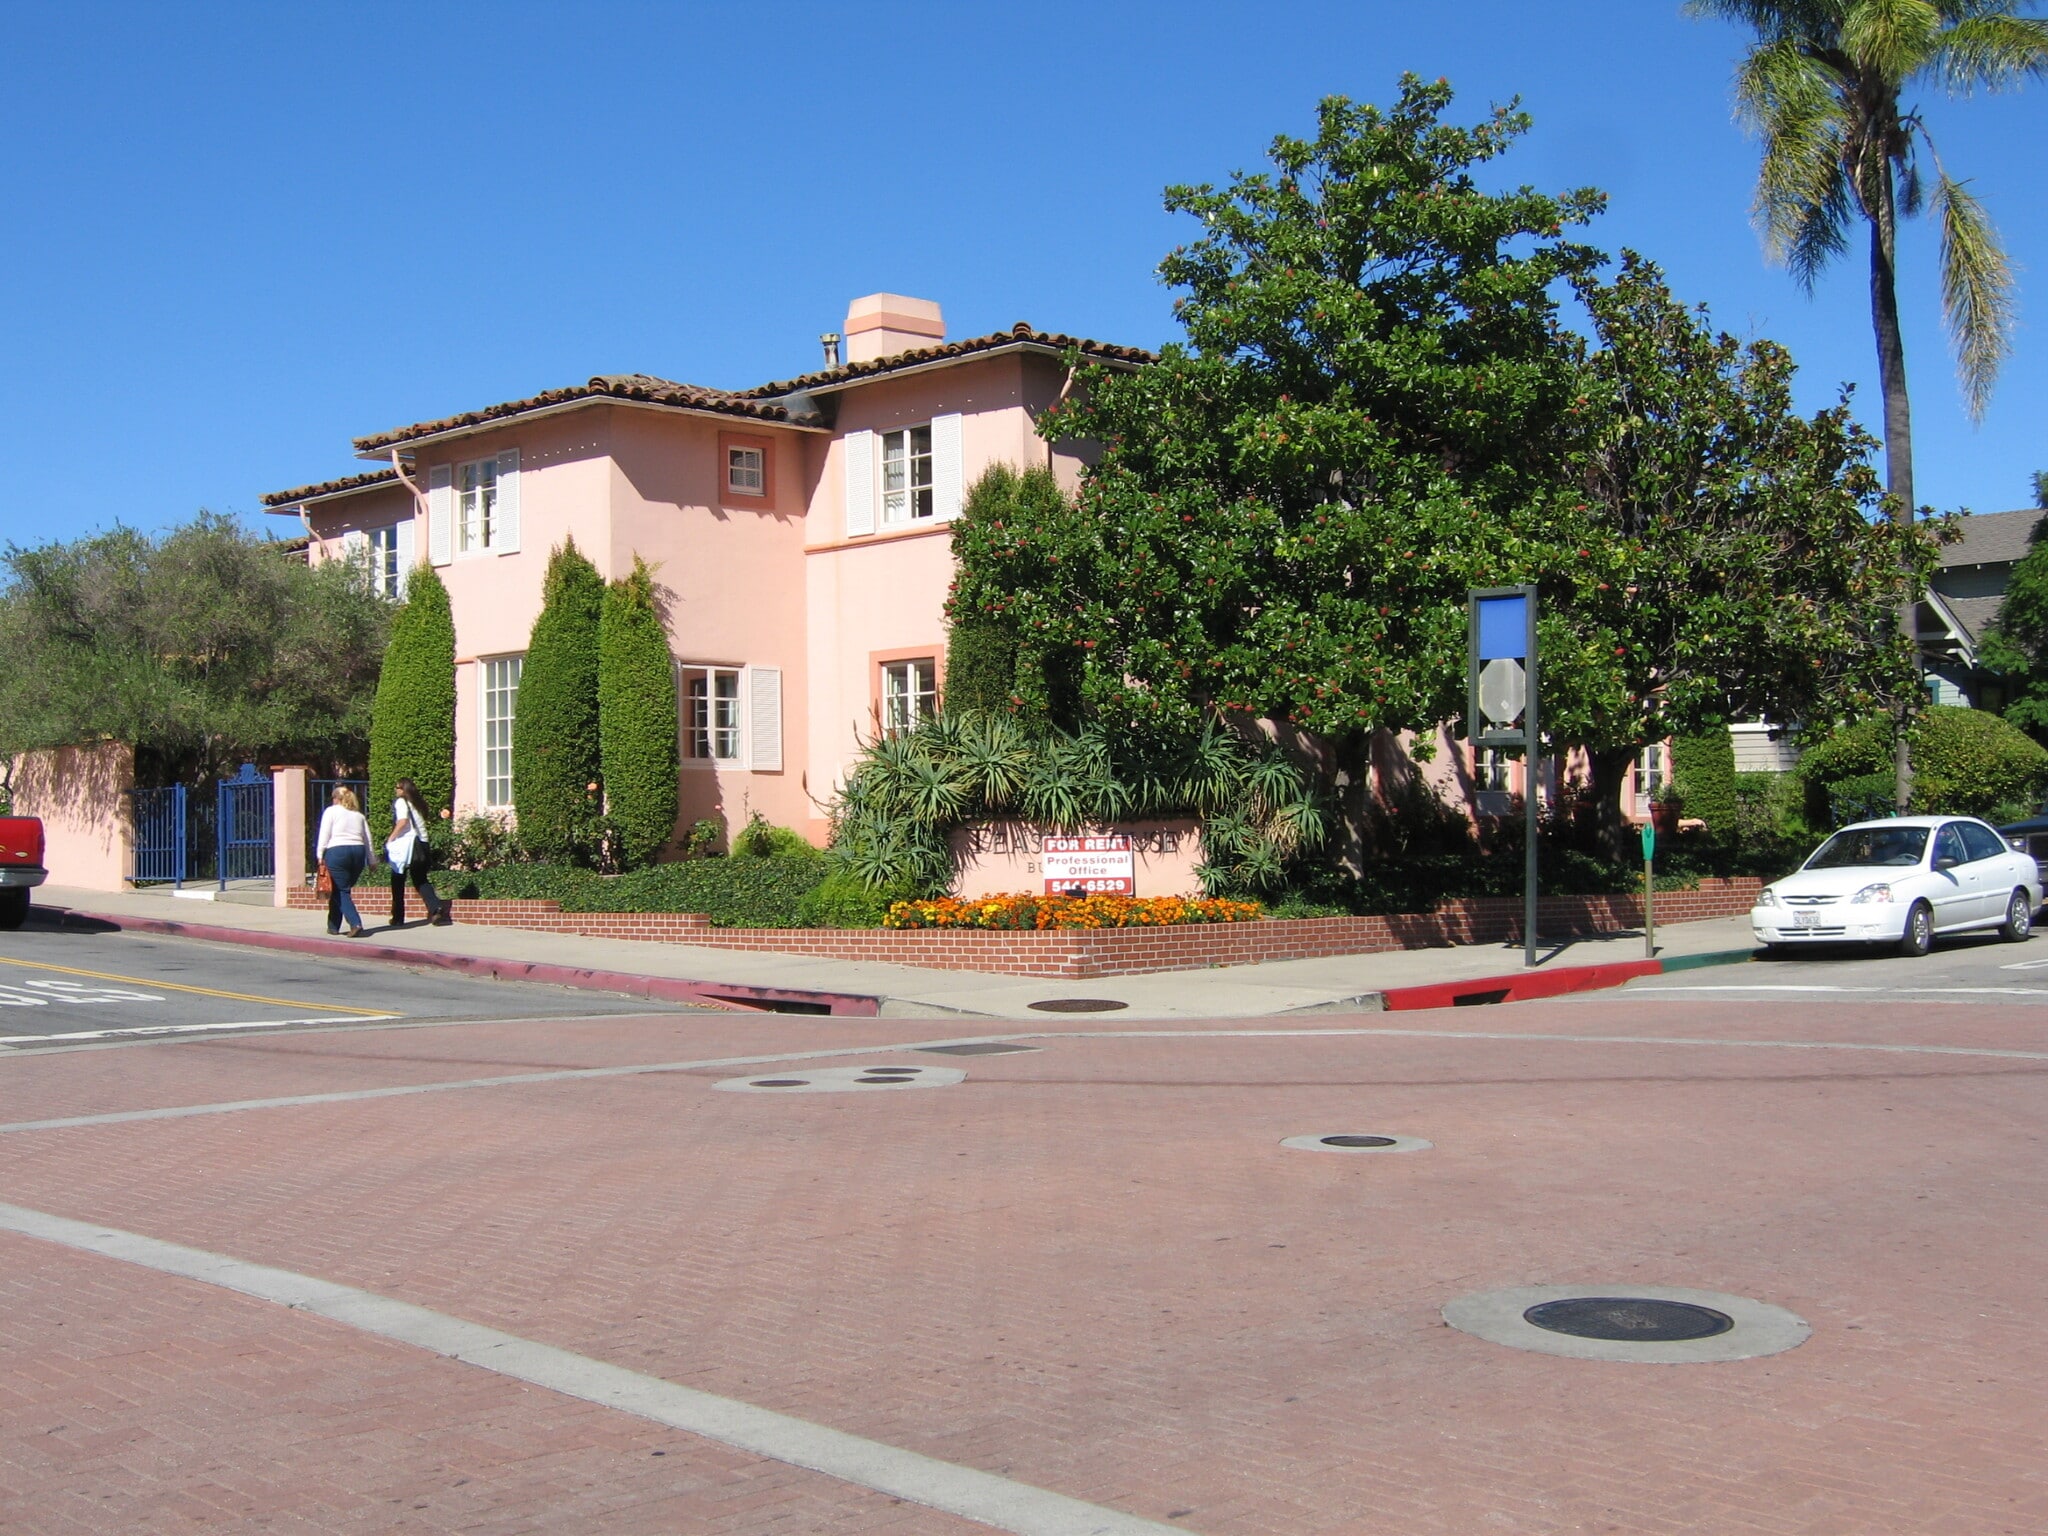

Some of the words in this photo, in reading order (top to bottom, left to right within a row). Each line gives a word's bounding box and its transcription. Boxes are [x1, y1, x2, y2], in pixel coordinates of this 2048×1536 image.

[1047, 838, 1080, 851] FOR
[1085, 836, 1126, 850] RENT
[1047, 854, 1129, 865] Professional
[1068, 866, 1107, 875] Office
